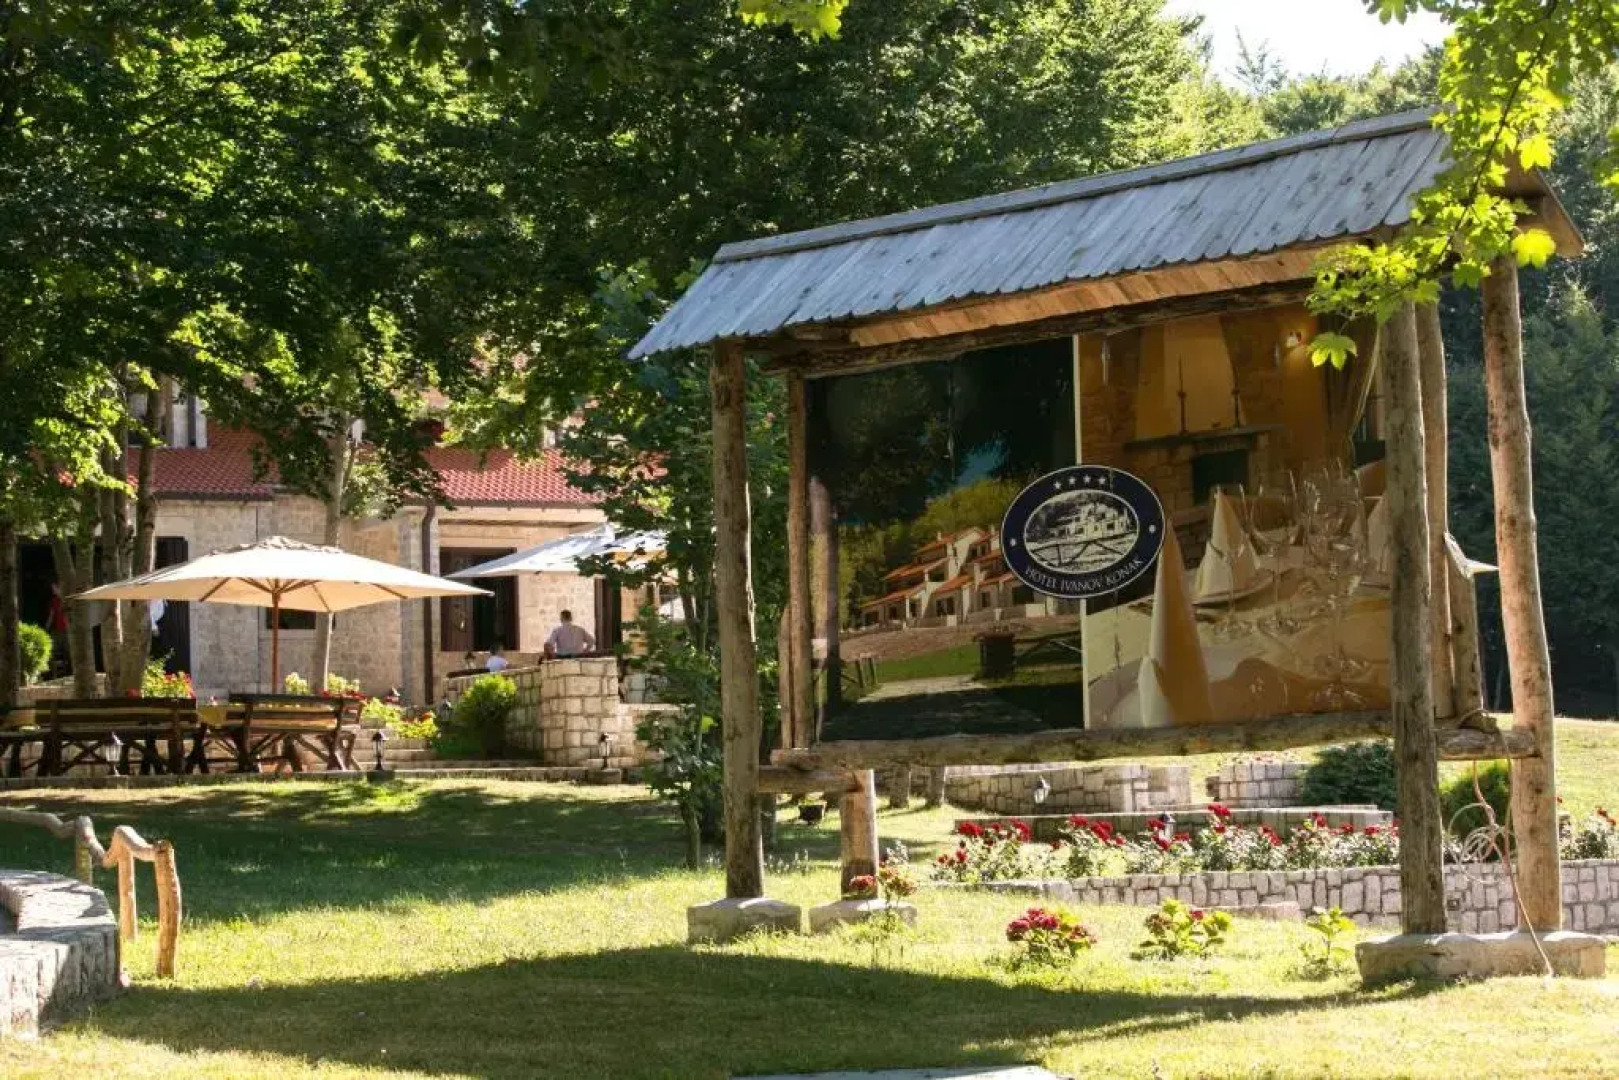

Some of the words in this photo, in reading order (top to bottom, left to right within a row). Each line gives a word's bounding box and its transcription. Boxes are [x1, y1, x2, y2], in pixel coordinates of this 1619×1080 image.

[1025, 565, 1056, 588] HOTEL
[1060, 577, 1101, 592] IVANOV
[1106, 555, 1143, 586] KONAK
